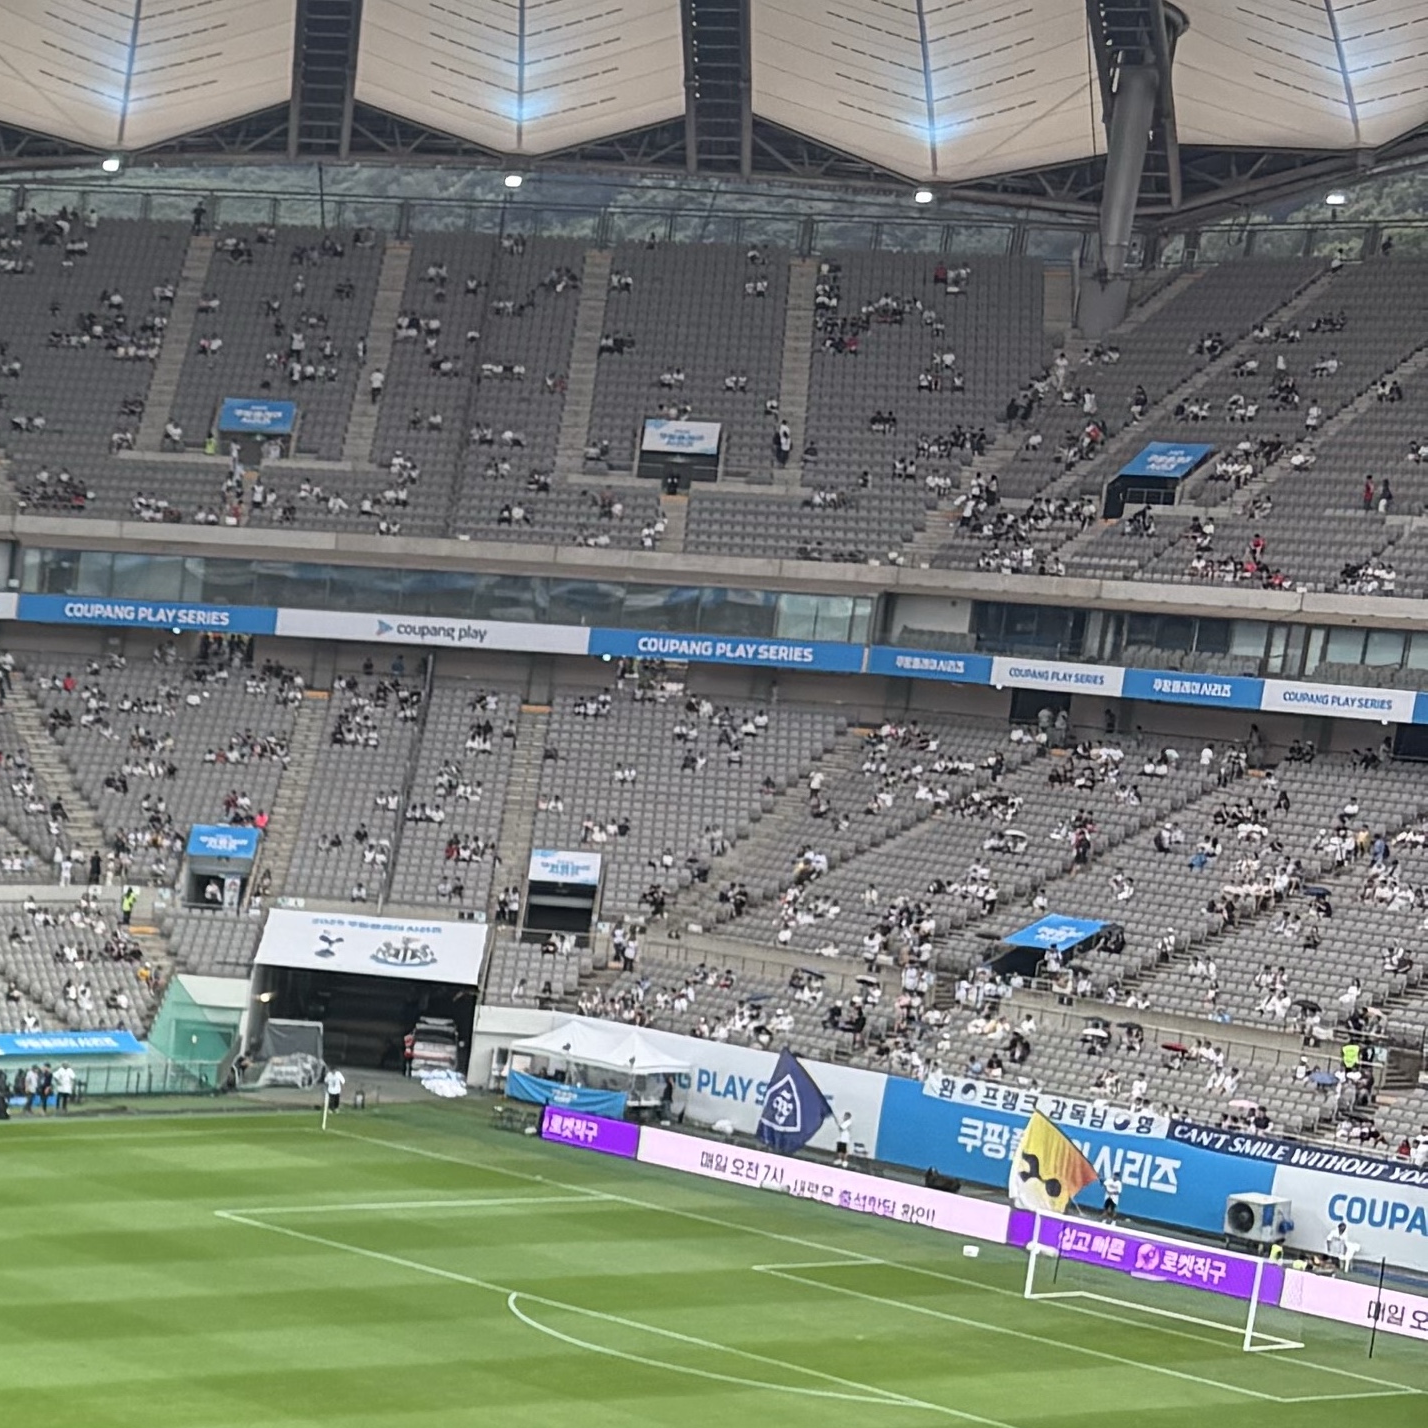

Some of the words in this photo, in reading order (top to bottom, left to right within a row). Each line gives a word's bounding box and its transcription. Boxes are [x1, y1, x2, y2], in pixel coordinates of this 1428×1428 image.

[65, 602, 135, 618] COUPANG
[138, 605, 176, 623] PLAY
[177, 609, 230, 626] SERIES
[397, 624, 456, 641] coupang
[458, 626, 488, 643] play
[638, 637, 714, 656] COUPANG
[716, 640, 752, 658] PLAY
[754, 645, 813, 662] SERIES
[1009, 666, 1049, 680] COUPANG
[1051, 669, 1073, 682] PLAY
[1074, 672, 1104, 686] SERIES
[1283, 691, 1329, 705] COUPANG
[1331, 694, 1356, 708] PLAY
[1357, 698, 1392, 711] SERIES
[696, 1068, 754, 1104] PLAY
[939, 1077, 956, 1099] 환
[982, 1085, 1039, 1114] 프랭크
[1048, 1099, 1108, 1129] 감독님
[1136, 1114, 1155, 1135] 영
[700, 1150, 729, 1173] 매일
[731, 1157, 759, 1181] 오전
[1173, 1123, 1226, 1150] CAN'T
[1228, 1136, 1290, 1163] SMILE
[1290, 1148, 1383, 1180] WITHOUT
[1092, 1145, 1183, 1195] 시리즈
[1328, 1193, 1428, 1237] COUPA
[1159, 1249, 1227, 1285] 로켓직구
[1367, 1300, 1406, 1327] 매일
